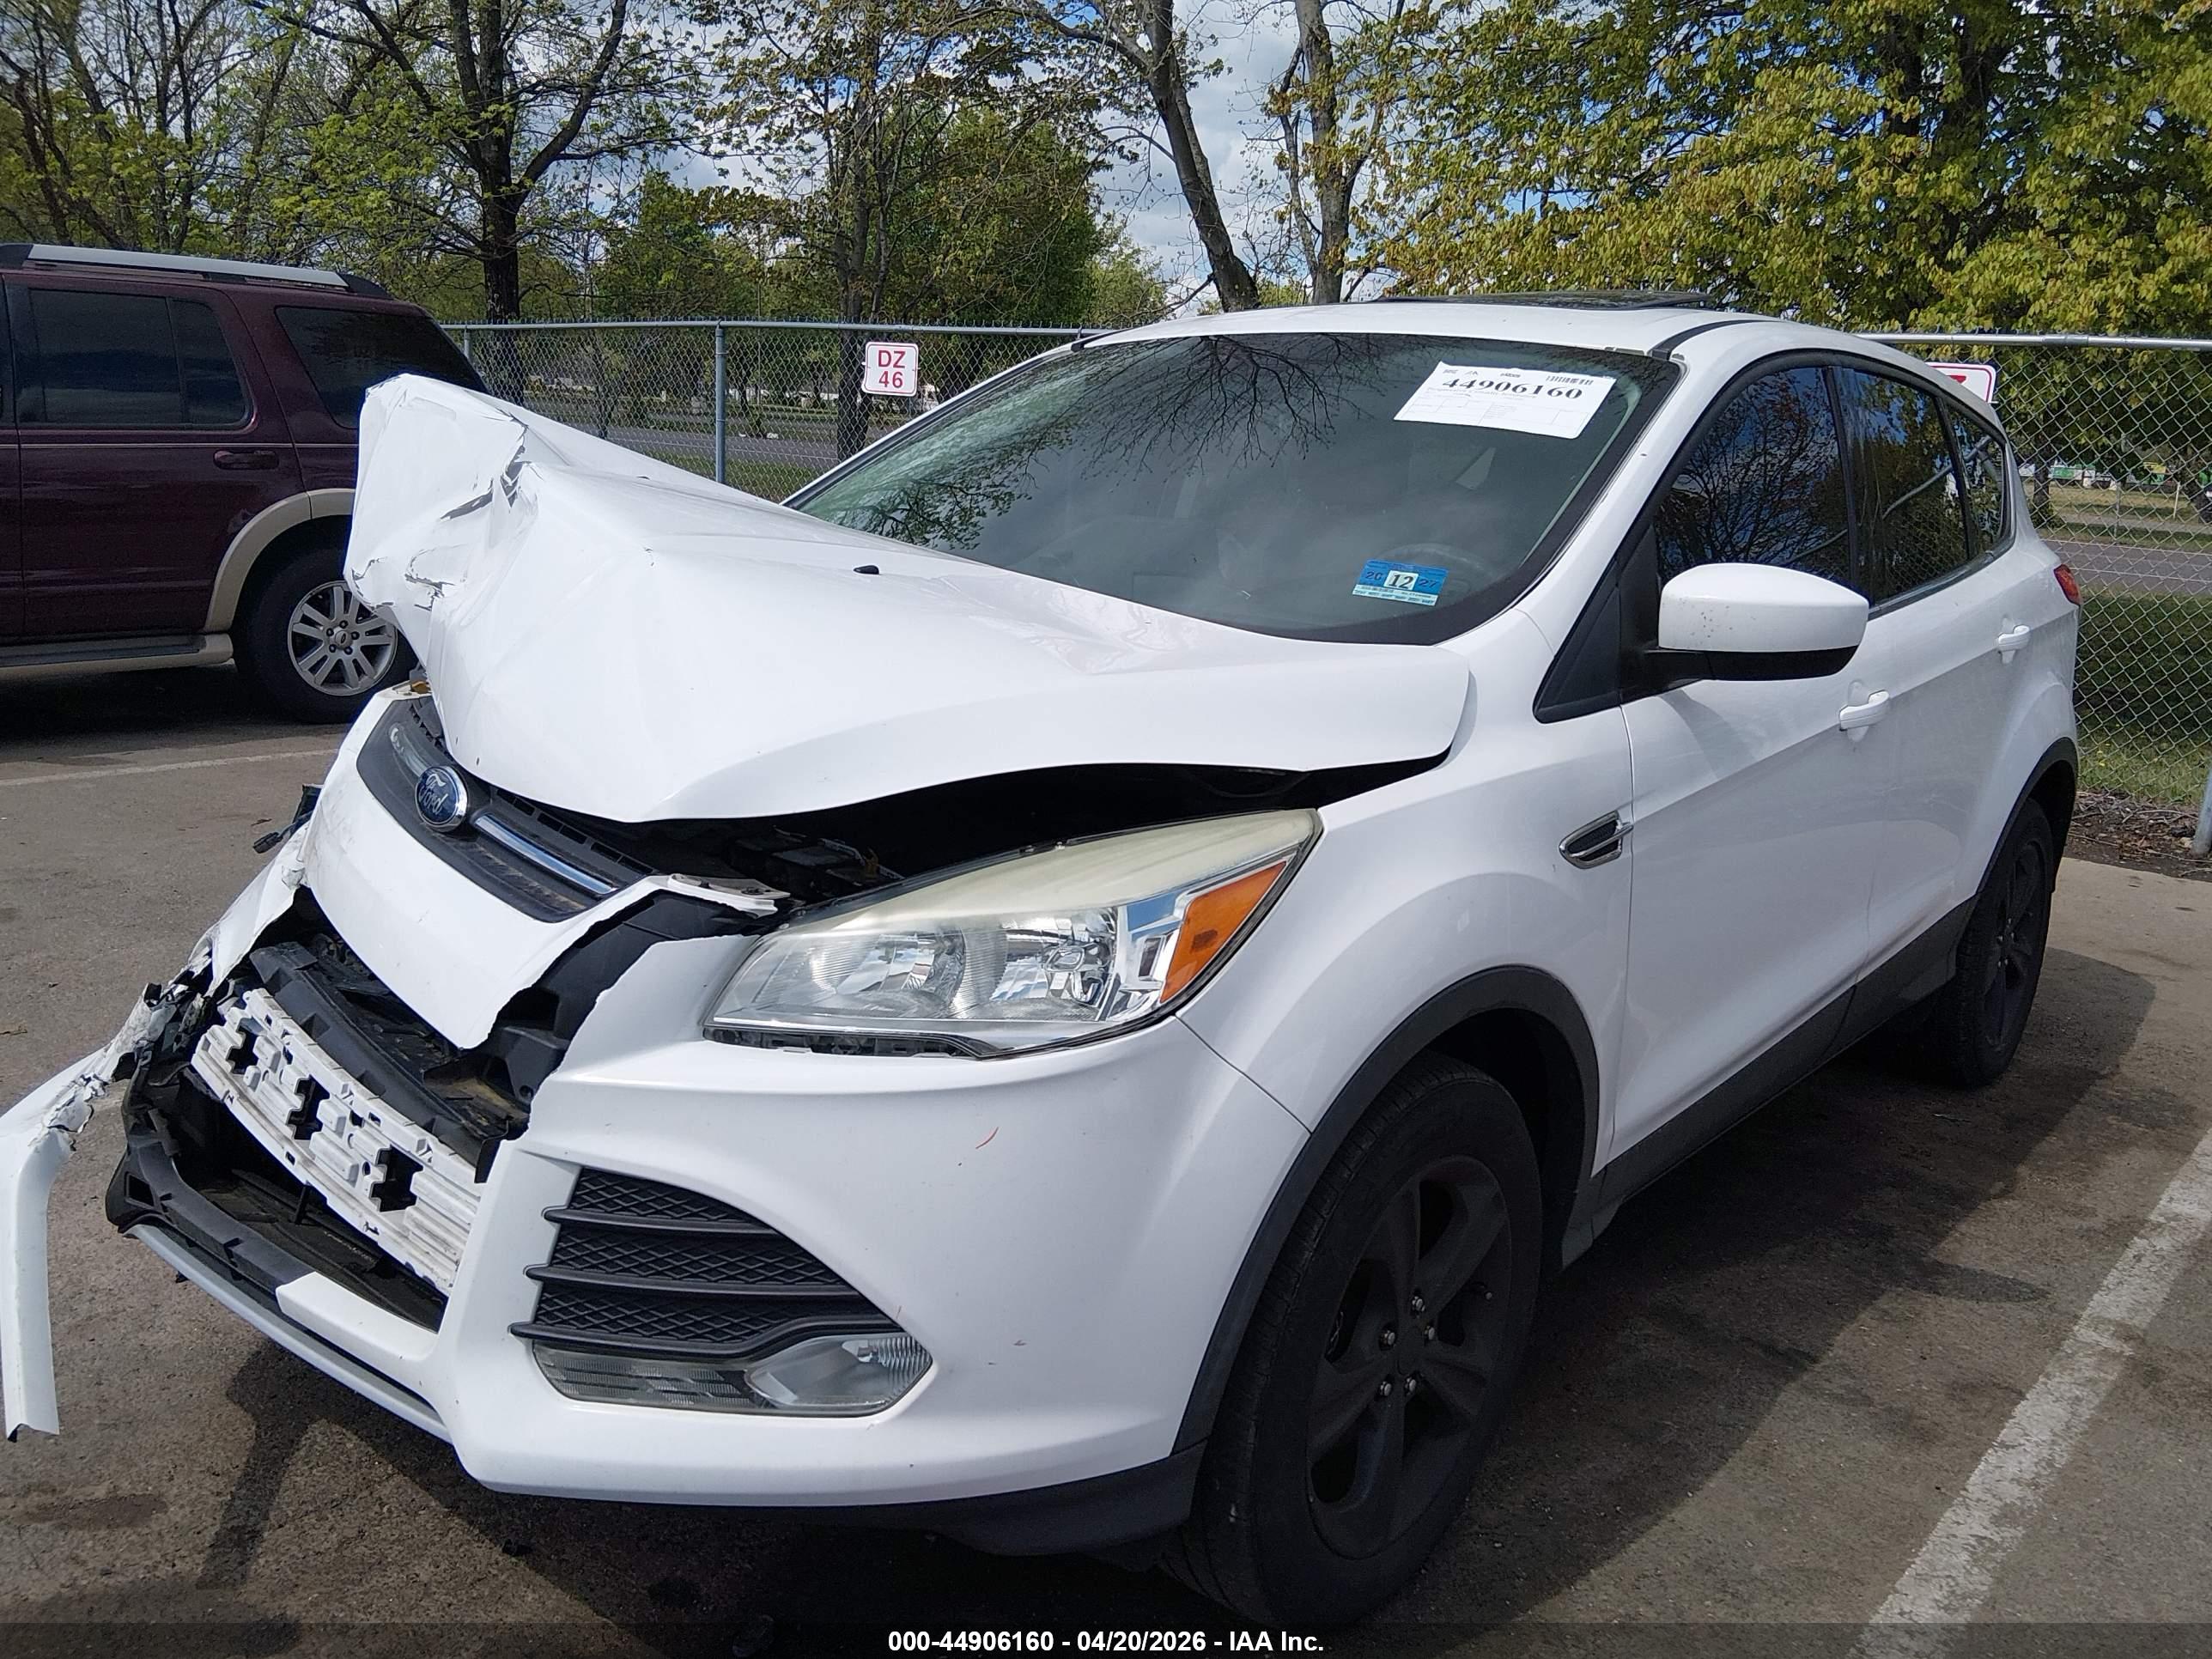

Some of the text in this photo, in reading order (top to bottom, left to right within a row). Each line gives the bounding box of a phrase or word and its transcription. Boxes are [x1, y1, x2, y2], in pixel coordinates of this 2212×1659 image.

[878, 349, 907, 369] DZ
[878, 370, 904, 389] 46
[1442, 378, 1583, 400] 44906160
[1388, 573, 1415, 590] 12
[1418, 578, 1440, 589] 27
[418, 773, 449, 815] Ford
